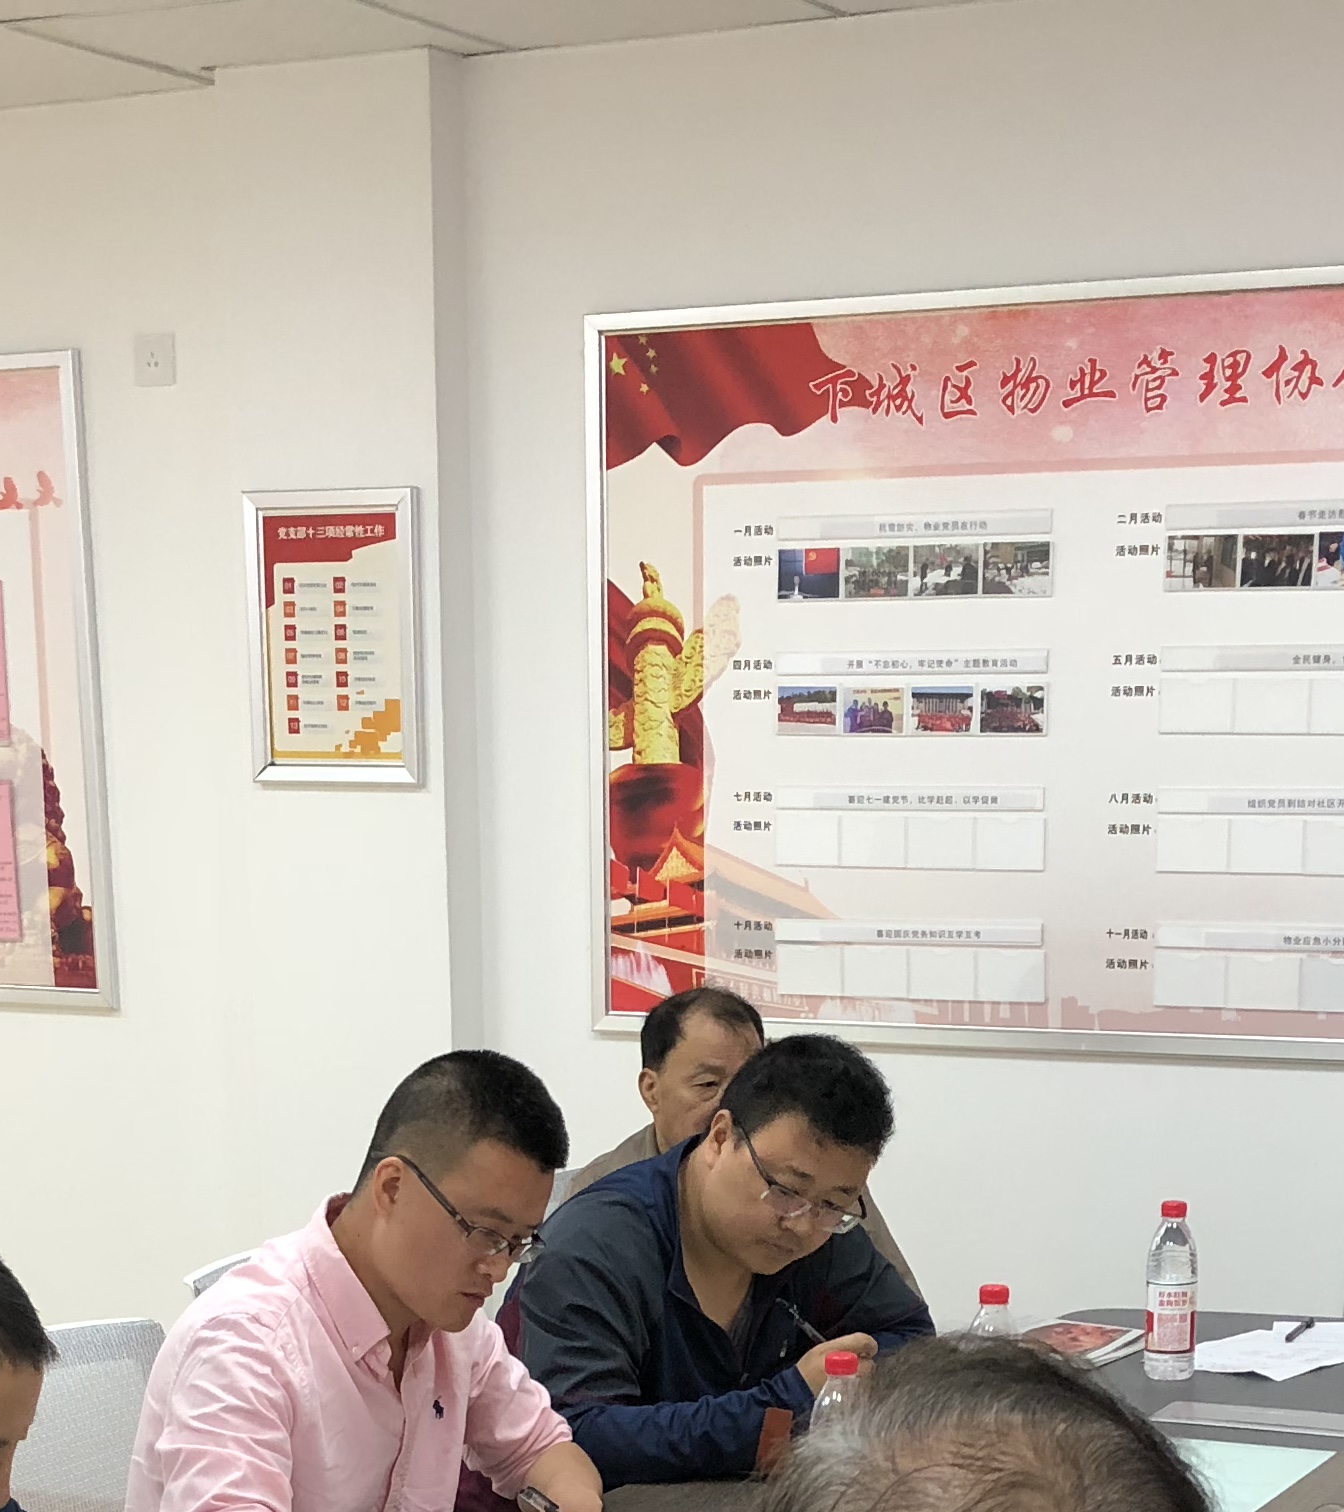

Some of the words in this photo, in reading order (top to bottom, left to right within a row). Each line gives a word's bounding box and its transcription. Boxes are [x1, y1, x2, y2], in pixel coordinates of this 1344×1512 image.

[277, 523, 386, 540] 党支部十三项经常性工作
[733, 555, 774, 567] 活动照片
[733, 689, 773, 701] 活动照片
